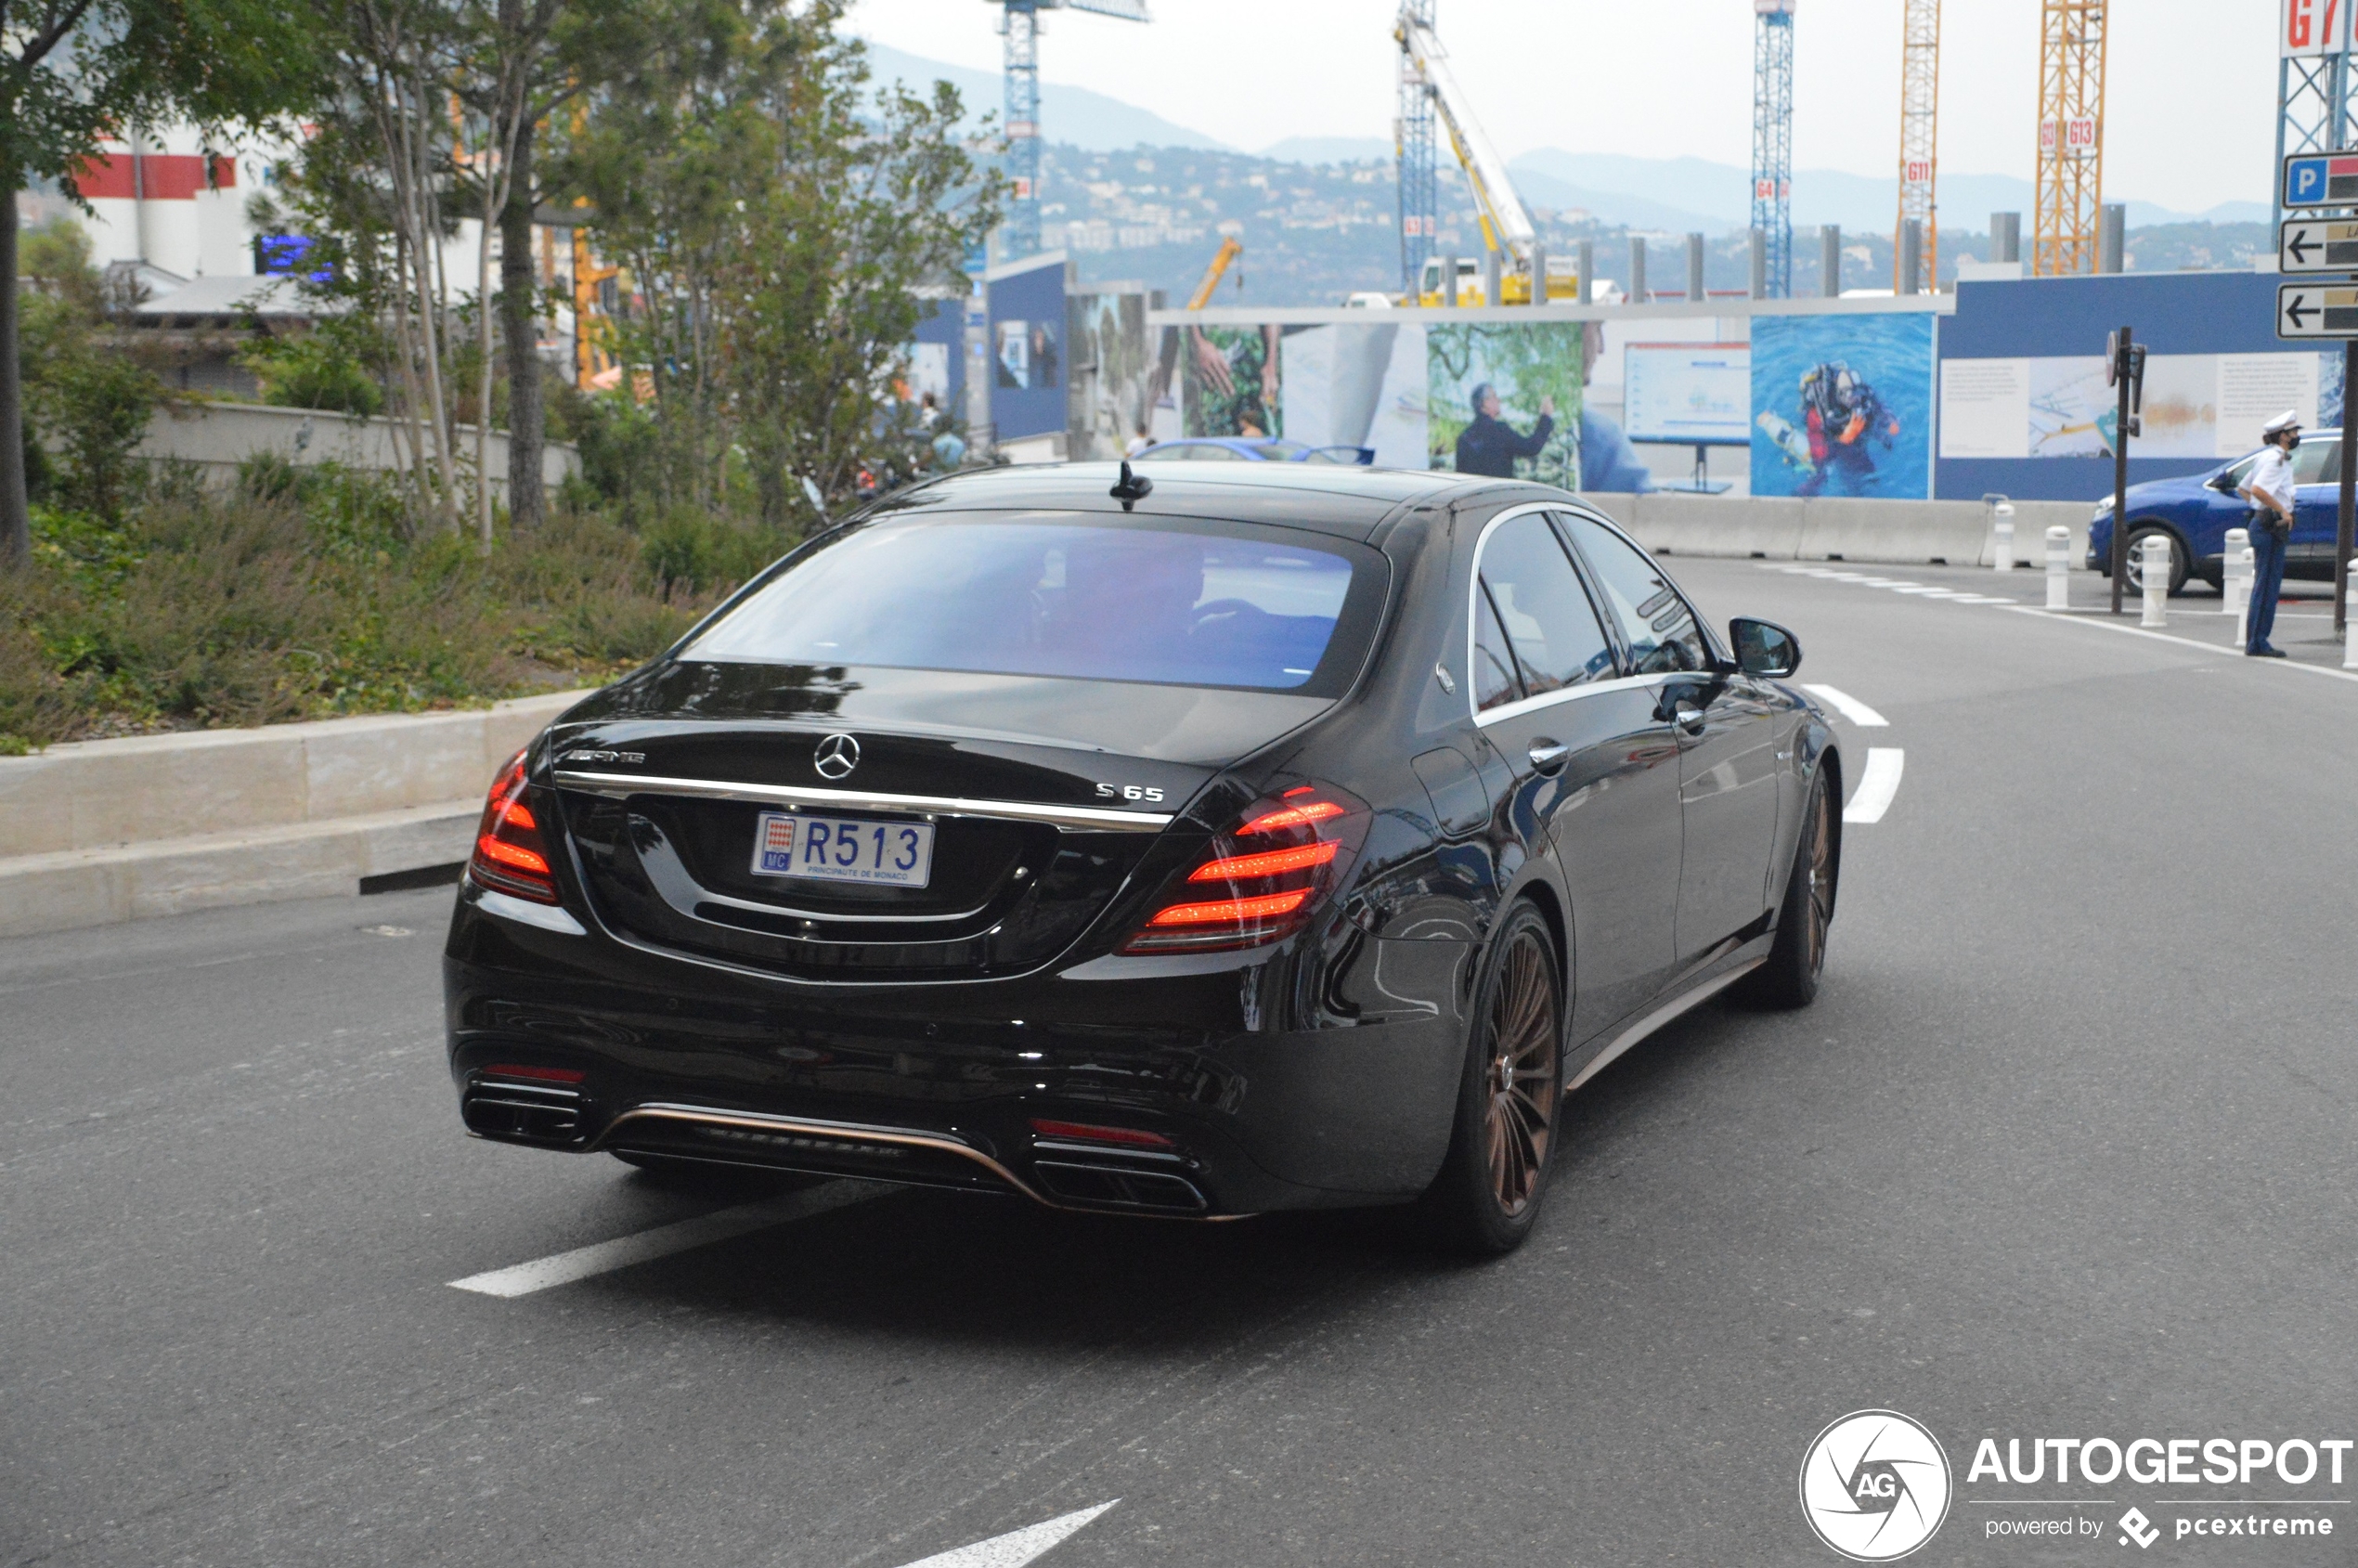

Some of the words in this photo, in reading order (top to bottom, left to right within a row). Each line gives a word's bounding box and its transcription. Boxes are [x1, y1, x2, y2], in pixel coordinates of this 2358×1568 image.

[2070, 121, 2092, 144] G13
[1909, 162, 1928, 180] G11
[2299, 168, 2317, 195] P
[1095, 783, 1114, 797] S
[1123, 785, 1164, 802] 65
[804, 822, 918, 871] R513
[767, 853, 786, 868] MC
[807, 865, 858, 877] PRINCIPAUTE
[861, 870, 871, 878] DE
[875, 872, 908, 880] MONACO
